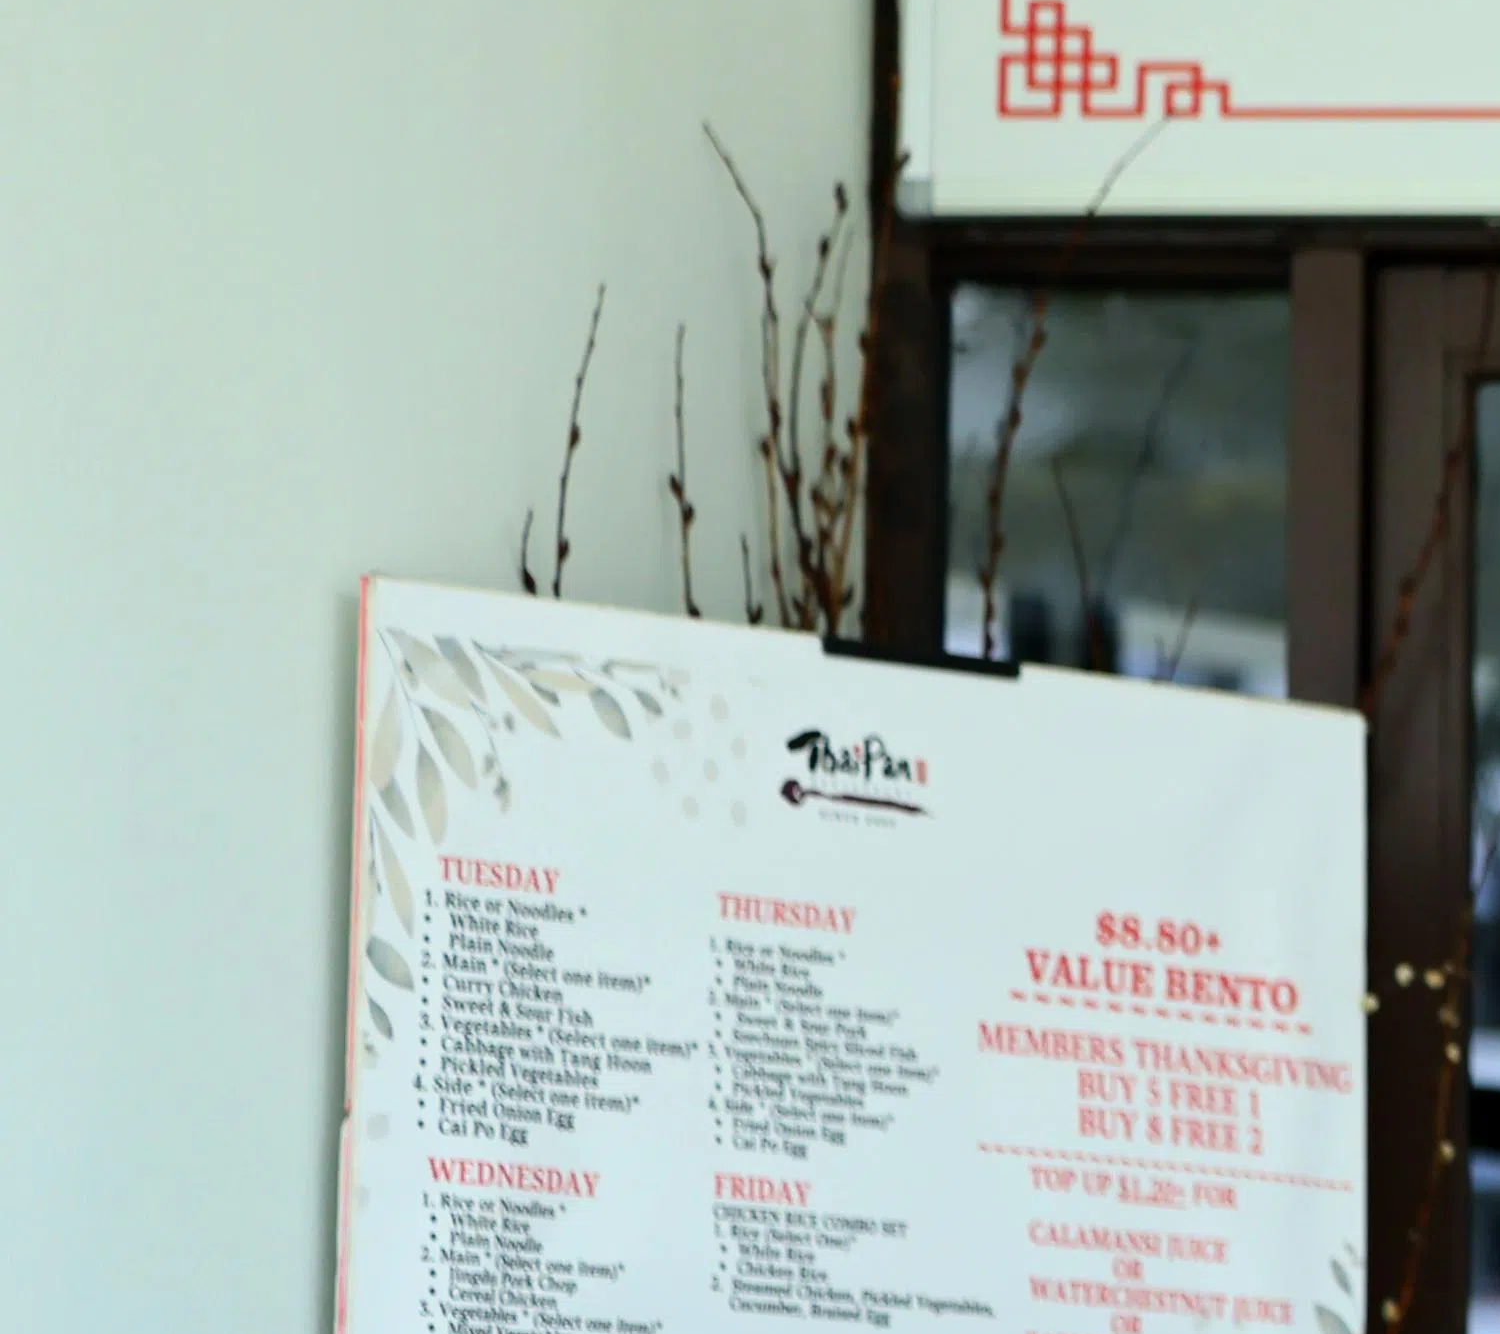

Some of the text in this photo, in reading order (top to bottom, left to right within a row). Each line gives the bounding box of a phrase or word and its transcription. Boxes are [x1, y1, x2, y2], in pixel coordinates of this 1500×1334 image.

[440, 856, 558, 893] TUESDAY
[444, 890, 480, 911] Rice
[484, 898, 502, 914] or
[507, 898, 574, 922] Noodles
[718, 893, 851, 932] THURSDAY
[449, 911, 538, 941] White Rice
[448, 932, 554, 961] Plain Noodle
[442, 952, 486, 972] Main
[502, 960, 557, 982] (Select
[561, 970, 593, 987] one
[1025, 948, 1298, 1012] VALUE BENTO
[442, 974, 562, 1001] Curry Chicken
[442, 995, 593, 1027] Sweet & Sour Fish
[440, 1013, 532, 1039] Vegetables
[610, 1037, 642, 1051] one
[440, 1035, 514, 1063] Cabbage
[518, 1045, 554, 1063] with
[440, 1055, 598, 1088] Pickled Vegetables
[978, 1022, 1350, 1091] MEMBERS THANKSGIVING
[1077, 1068, 1260, 1120] BUY 5 FREE 1
[439, 1096, 575, 1131] Fried Onion Egg
[1078, 1105, 1136, 1140] BUY
[1170, 1115, 1237, 1152] FREE
[1248, 1125, 1262, 1156] 2
[500, 1121, 529, 1147] Egg
[427, 1156, 596, 1196] WEDNESDAY
[714, 1173, 806, 1207] FRIDAY
[1030, 1164, 1077, 1191] TOP
[1081, 1170, 1113, 1195] UP
[1192, 1182, 1236, 1207] FOR
[1166, 1234, 1227, 1263] JUICE
[1112, 1258, 1142, 1280] OR
[1232, 1297, 1293, 1325] JUICE
